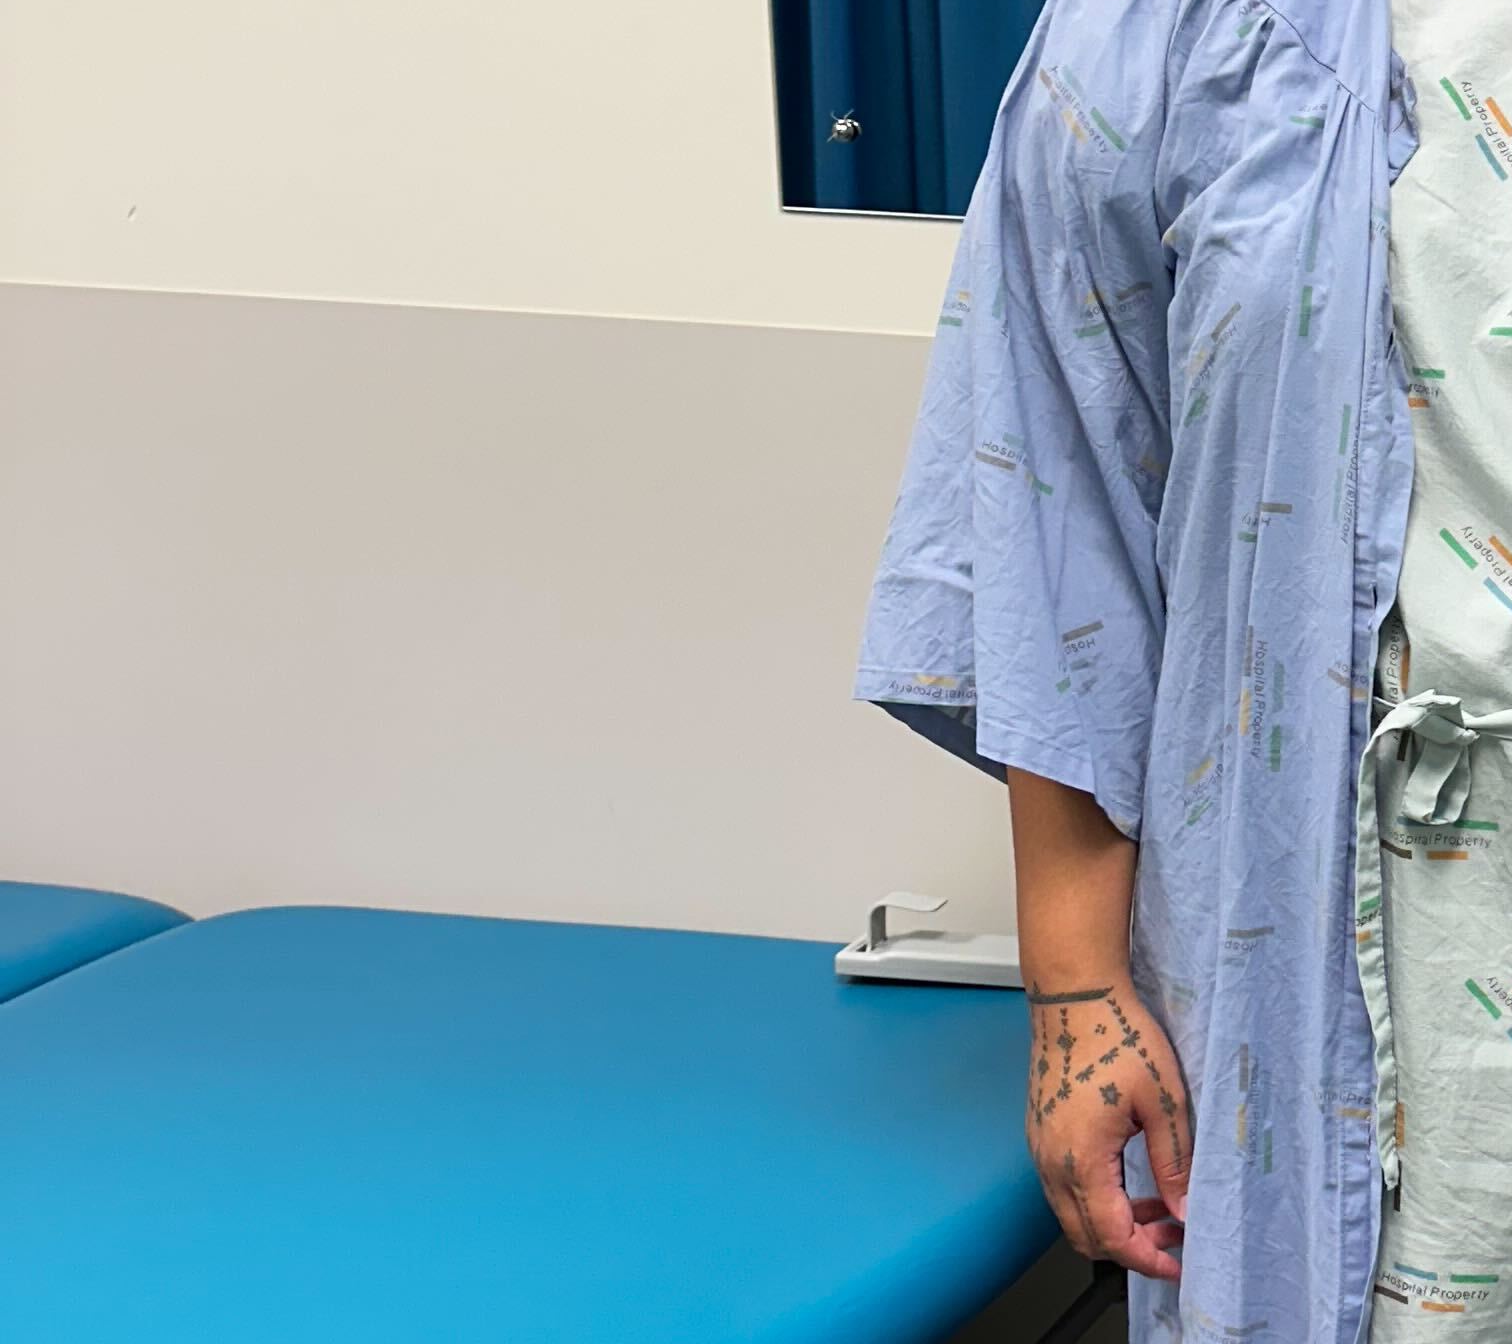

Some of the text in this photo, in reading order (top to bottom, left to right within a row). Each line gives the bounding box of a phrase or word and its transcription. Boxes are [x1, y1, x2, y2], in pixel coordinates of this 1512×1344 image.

[1461, 81, 1498, 138] Property
[1460, 526, 1505, 577] Property
[1255, 640, 1269, 698] Hospital
[1432, 835, 1493, 850] Property
[1380, 1272, 1491, 1303] Hospital Property
